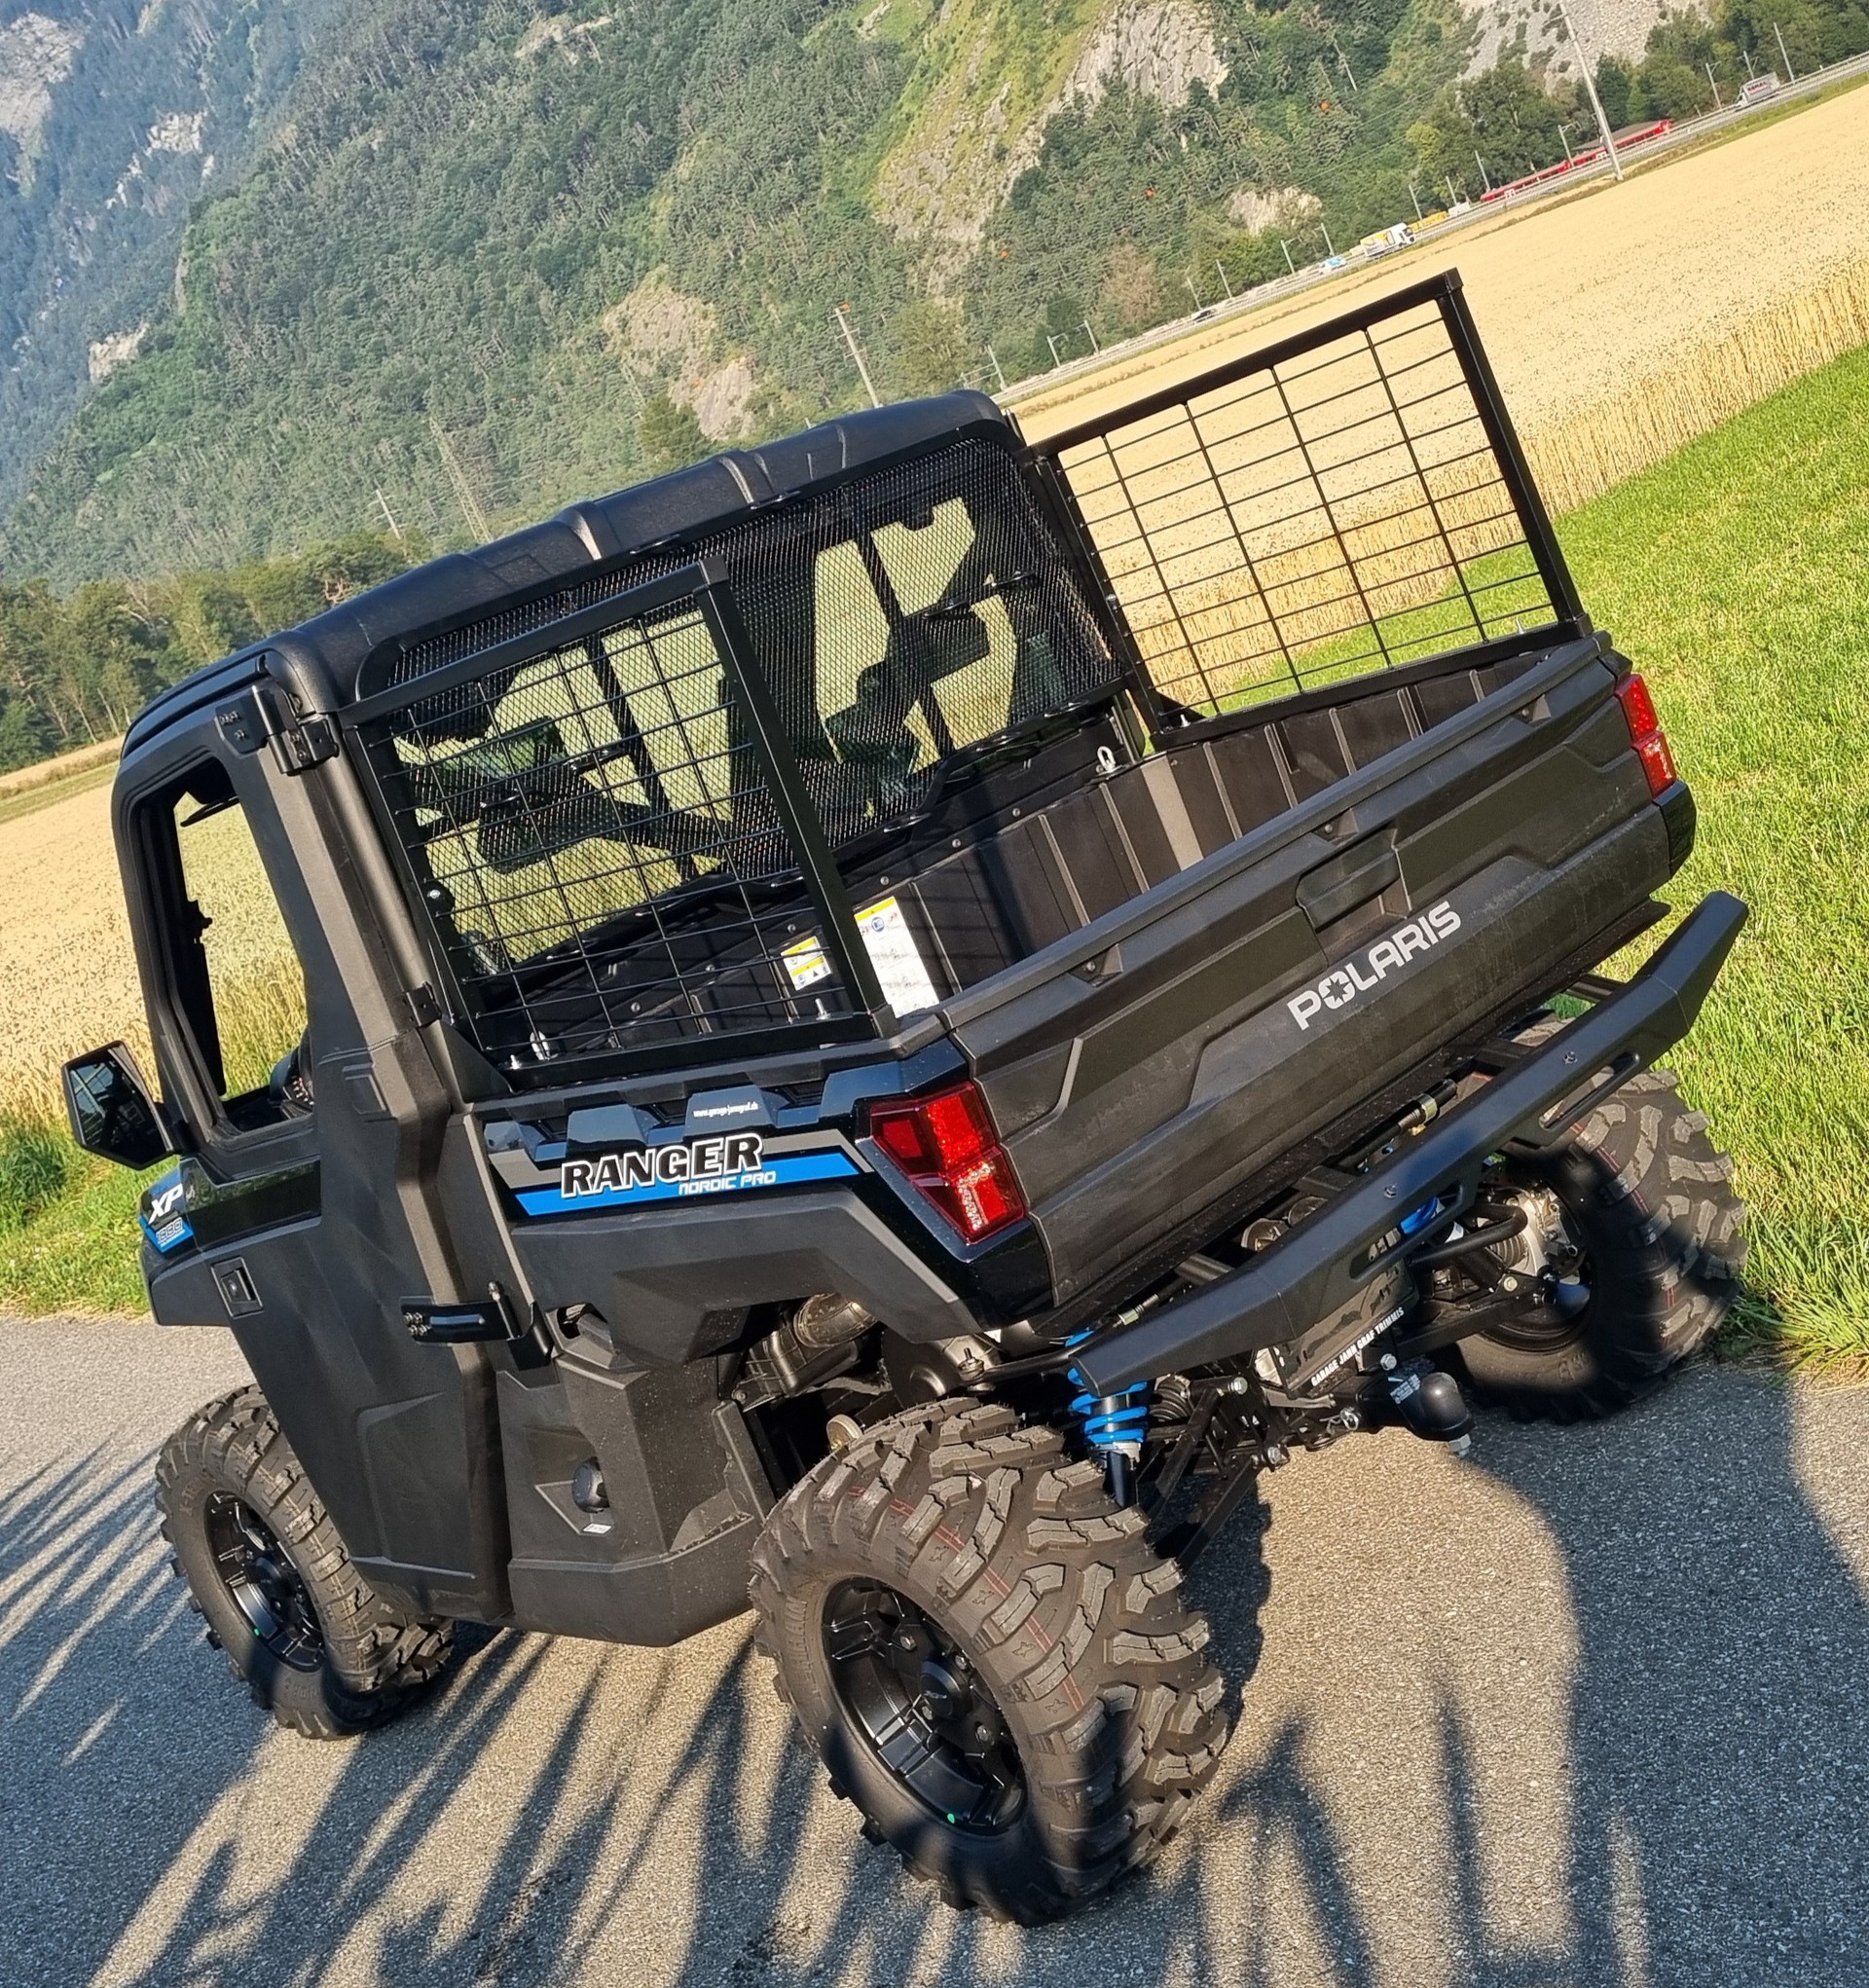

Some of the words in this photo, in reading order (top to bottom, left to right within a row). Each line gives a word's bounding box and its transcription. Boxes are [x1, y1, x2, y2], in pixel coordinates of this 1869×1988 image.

[1287, 901, 1461, 1031] POLARIS
[561, 1133, 763, 1198] RANGER
[678, 1176, 737, 1196] NORDIC
[741, 1170, 777, 1189] PRO
[148, 1183, 183, 1225] XP
[1310, 1359, 1339, 1386] GARAGE
[1338, 1344, 1358, 1365] JANN
[1357, 1330, 1375, 1349] GRAF
[1374, 1307, 1405, 1335] TRIMMIS
